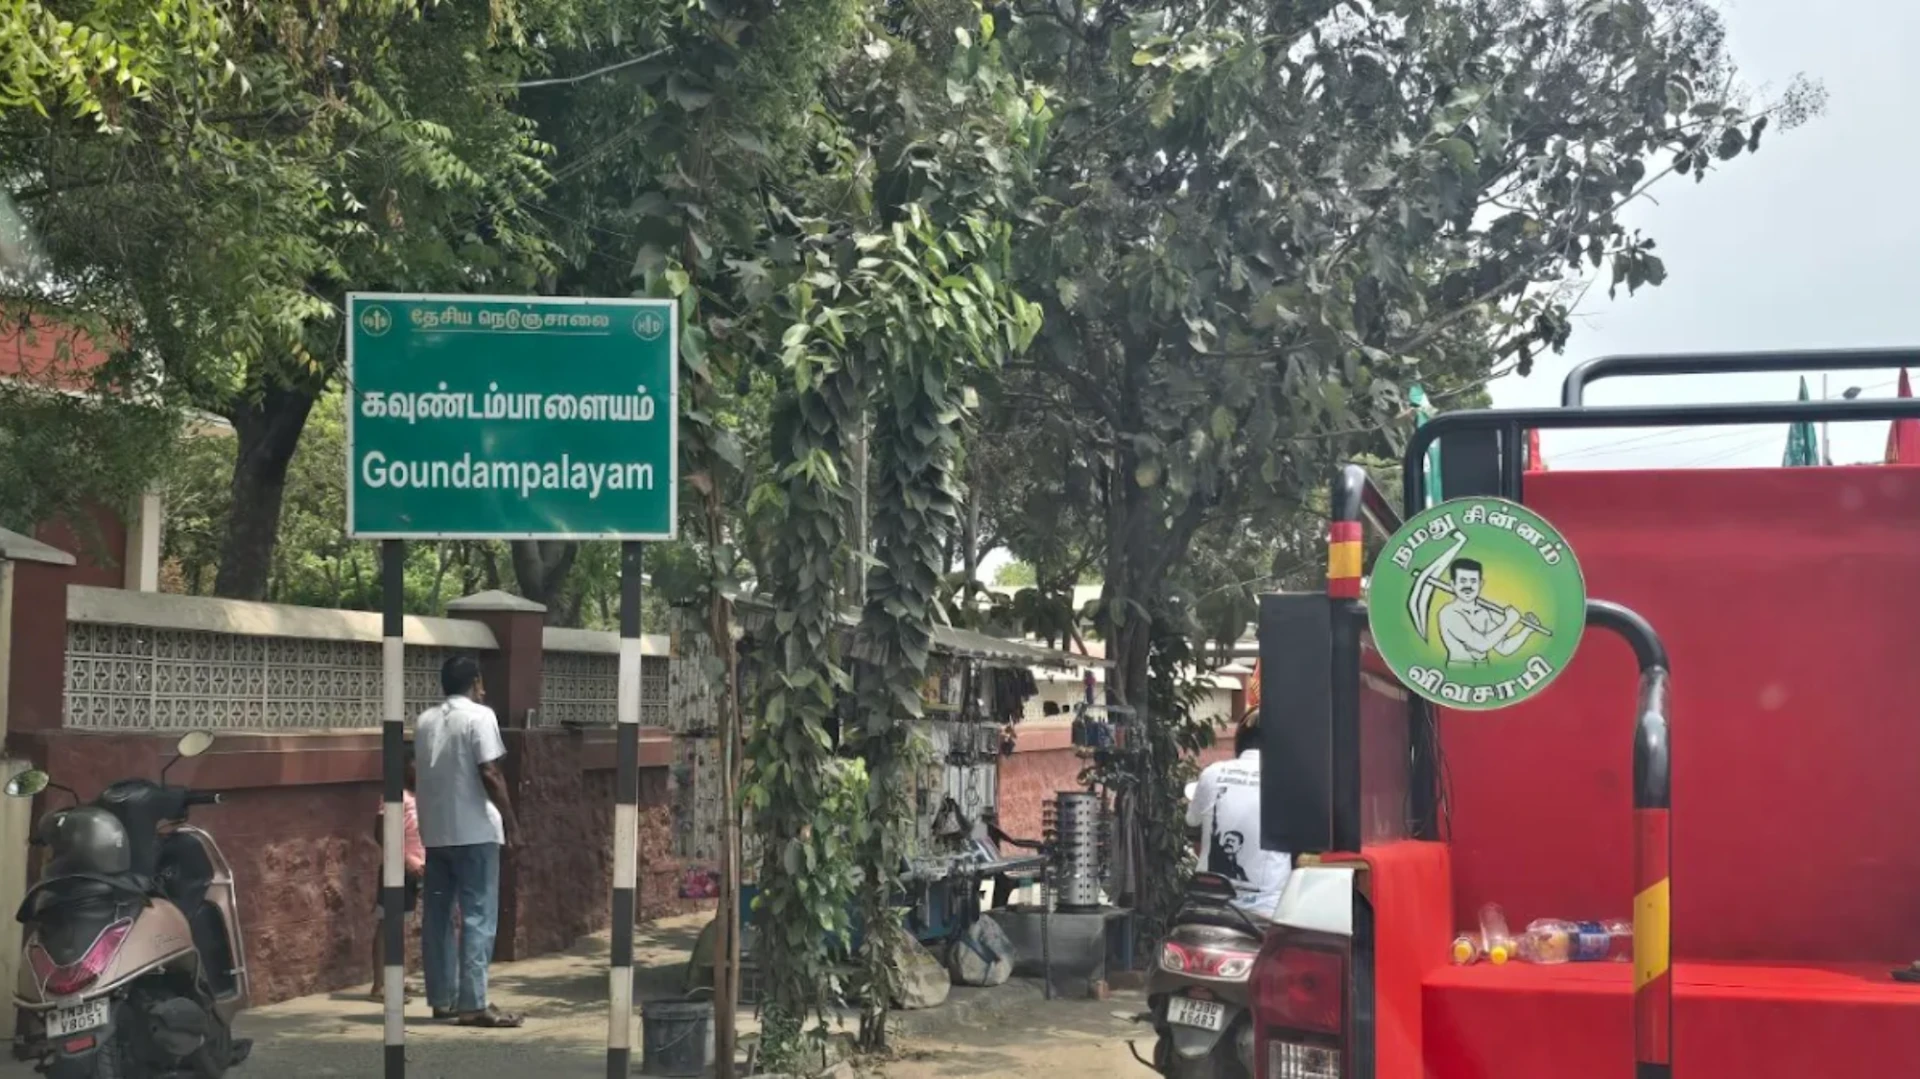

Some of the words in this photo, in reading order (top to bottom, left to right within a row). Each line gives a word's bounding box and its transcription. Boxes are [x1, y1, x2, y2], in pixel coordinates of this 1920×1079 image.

[410, 305, 473, 328] தேசிய
[478, 304, 610, 330] நெடுஞ்சாலை
[361, 380, 655, 425] கவுண்டம்பாளையம்
[362, 450, 653, 499] Goundampalayam
[1391, 512, 1457, 570] நமது
[1462, 504, 1562, 566] சின்னம்
[1407, 655, 1553, 704] விவசாயி
[60, 1011, 102, 1033] V8051
